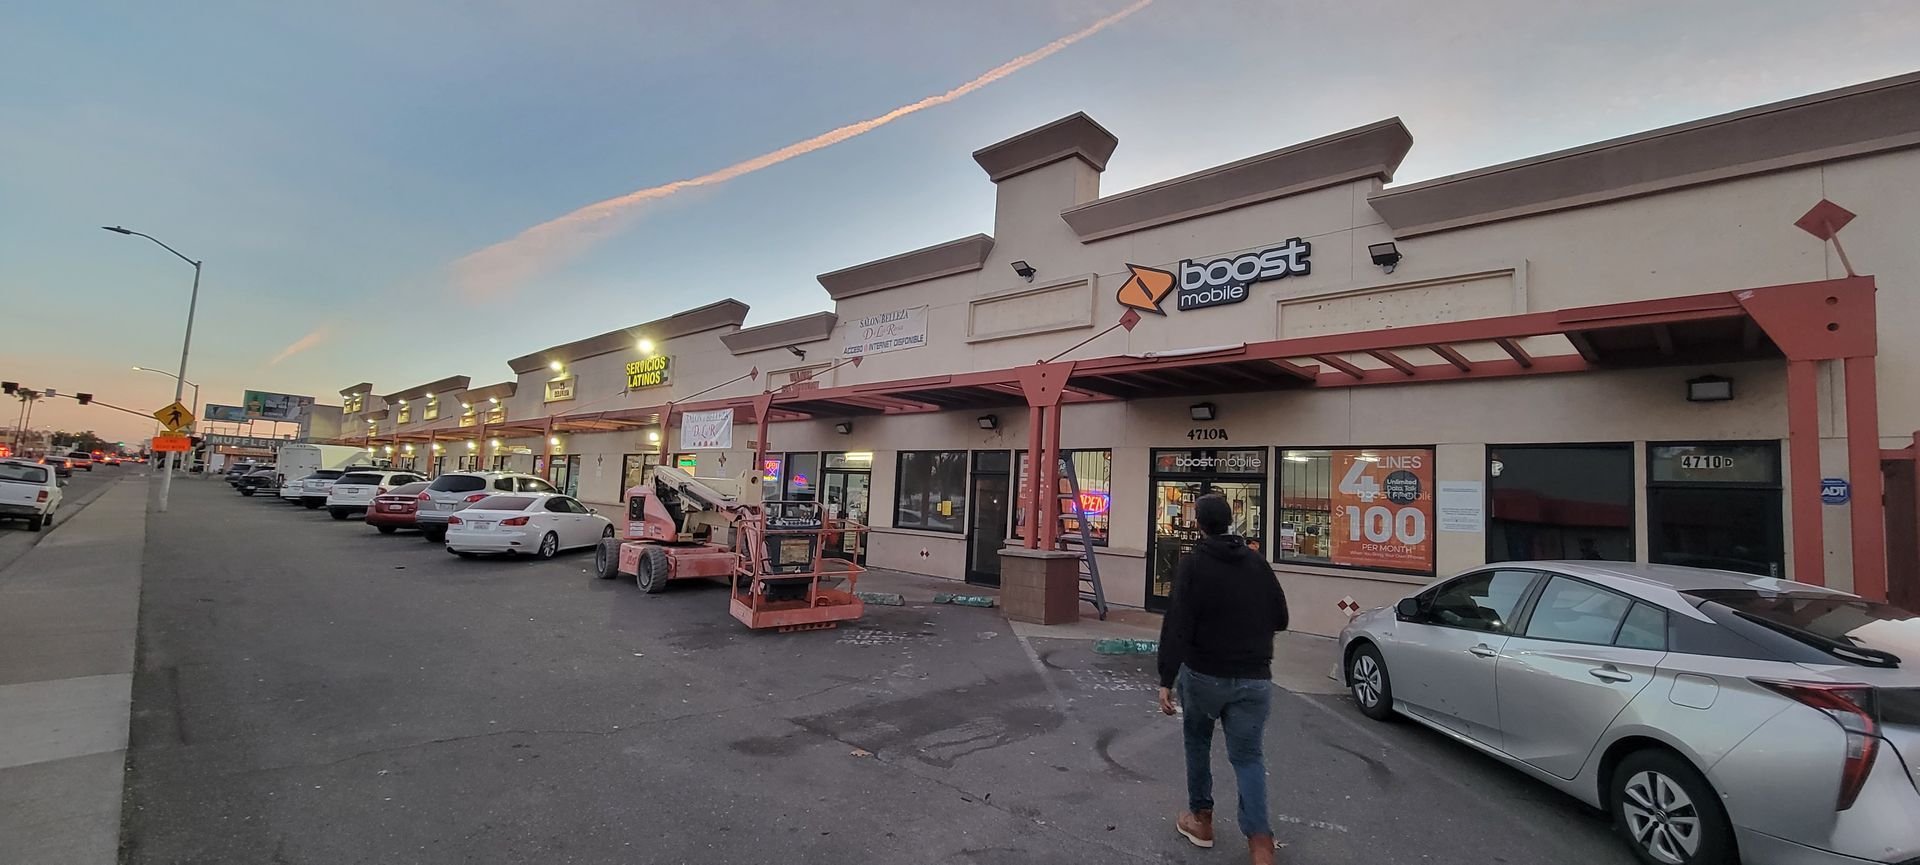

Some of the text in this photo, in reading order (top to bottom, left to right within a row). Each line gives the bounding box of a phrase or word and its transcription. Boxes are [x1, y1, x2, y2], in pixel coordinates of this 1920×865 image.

[1180, 240, 1306, 291] boost
[1181, 284, 1245, 307] mobile
[860, 316, 879, 328] SALON
[843, 345, 863, 355] ACCESO
[868, 339, 892, 351] INTERNET
[893, 334, 924, 347] DISPONIBLE
[626, 356, 666, 375] SERVICIOS
[628, 371, 661, 388] LATINOS
[1187, 429, 1228, 440] 4710A
[212, 435, 275, 447] MUFFLER
[1176, 456, 1261, 468] boostmobile
[1376, 456, 1422, 469] LINES
[1682, 456, 1732, 468] 4710 D
[1338, 458, 1380, 503] 4
[1821, 486, 1847, 496] ADT
[1362, 543, 1412, 554] PER MONTH
[1136, 642, 1148, 652] 20
